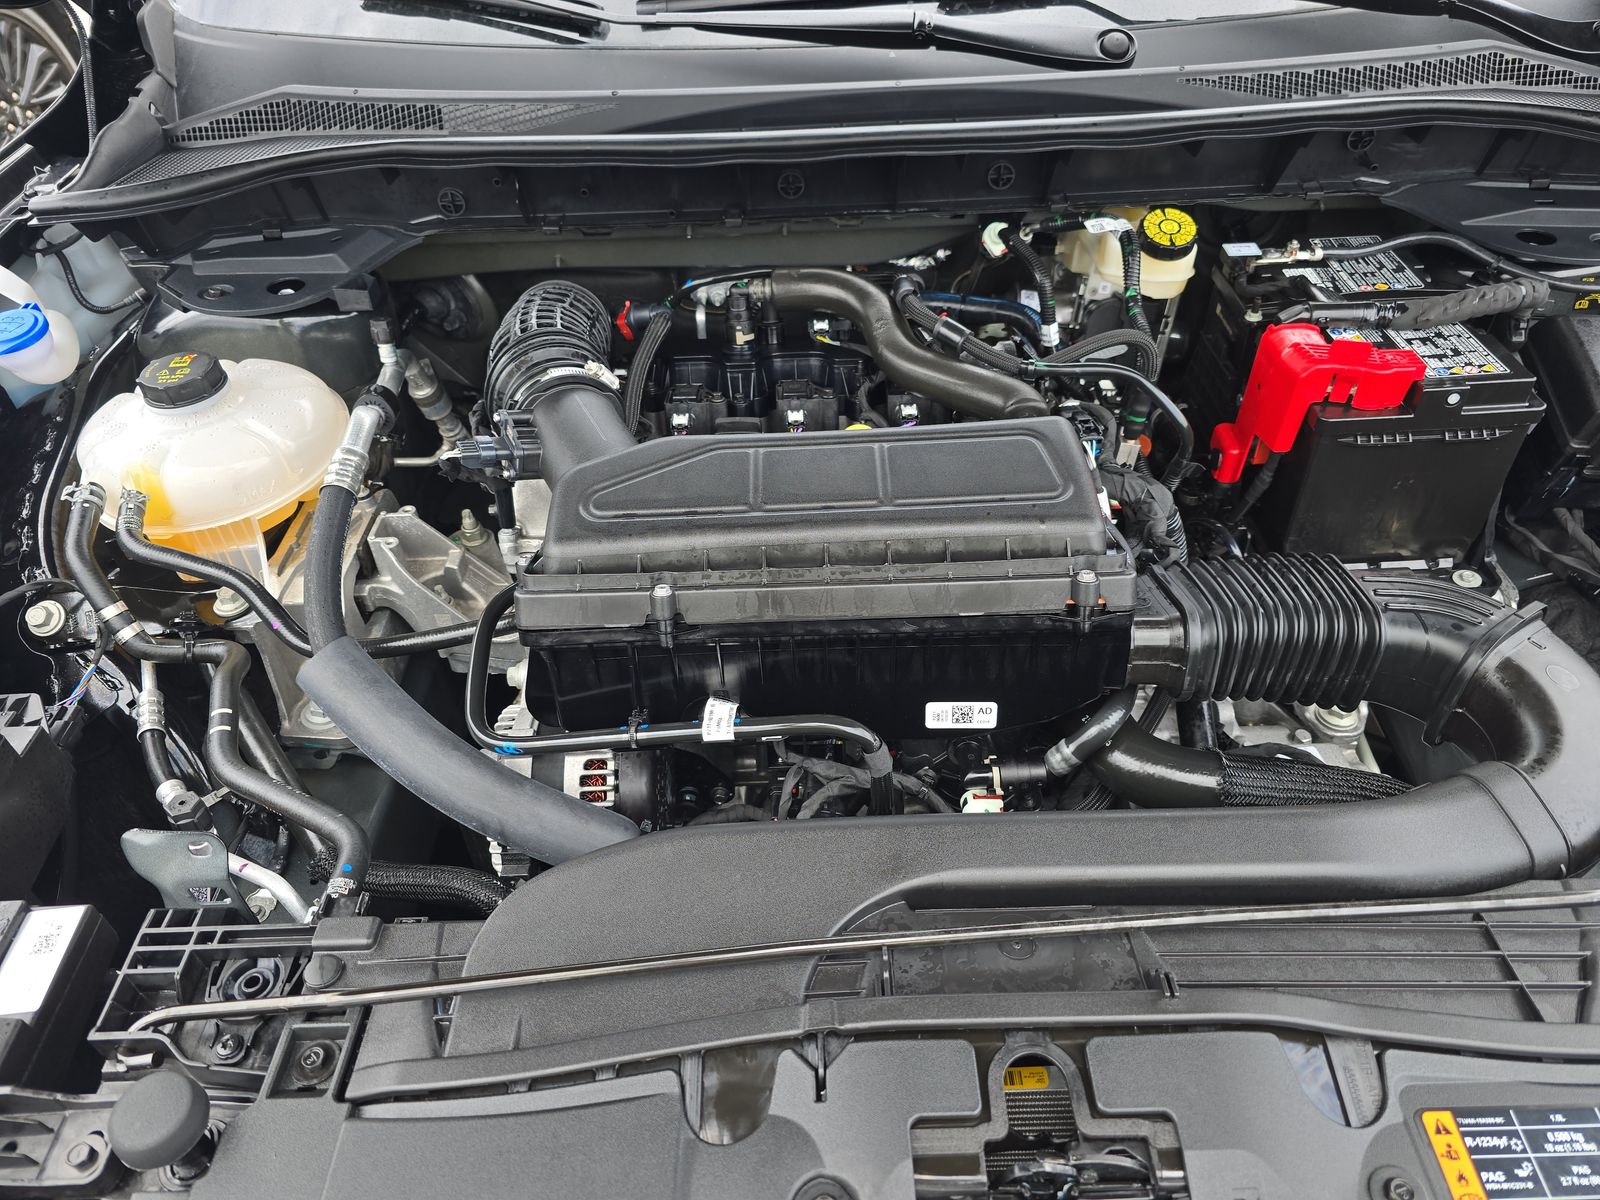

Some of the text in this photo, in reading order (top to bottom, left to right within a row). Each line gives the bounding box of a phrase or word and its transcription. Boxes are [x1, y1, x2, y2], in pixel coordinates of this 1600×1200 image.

[978, 707, 993, 715] AD
[1464, 1135, 1509, 1150] R-1234yf
[1571, 1165, 1592, 1175] PAG
[1480, 1171, 1506, 1183] PAG
